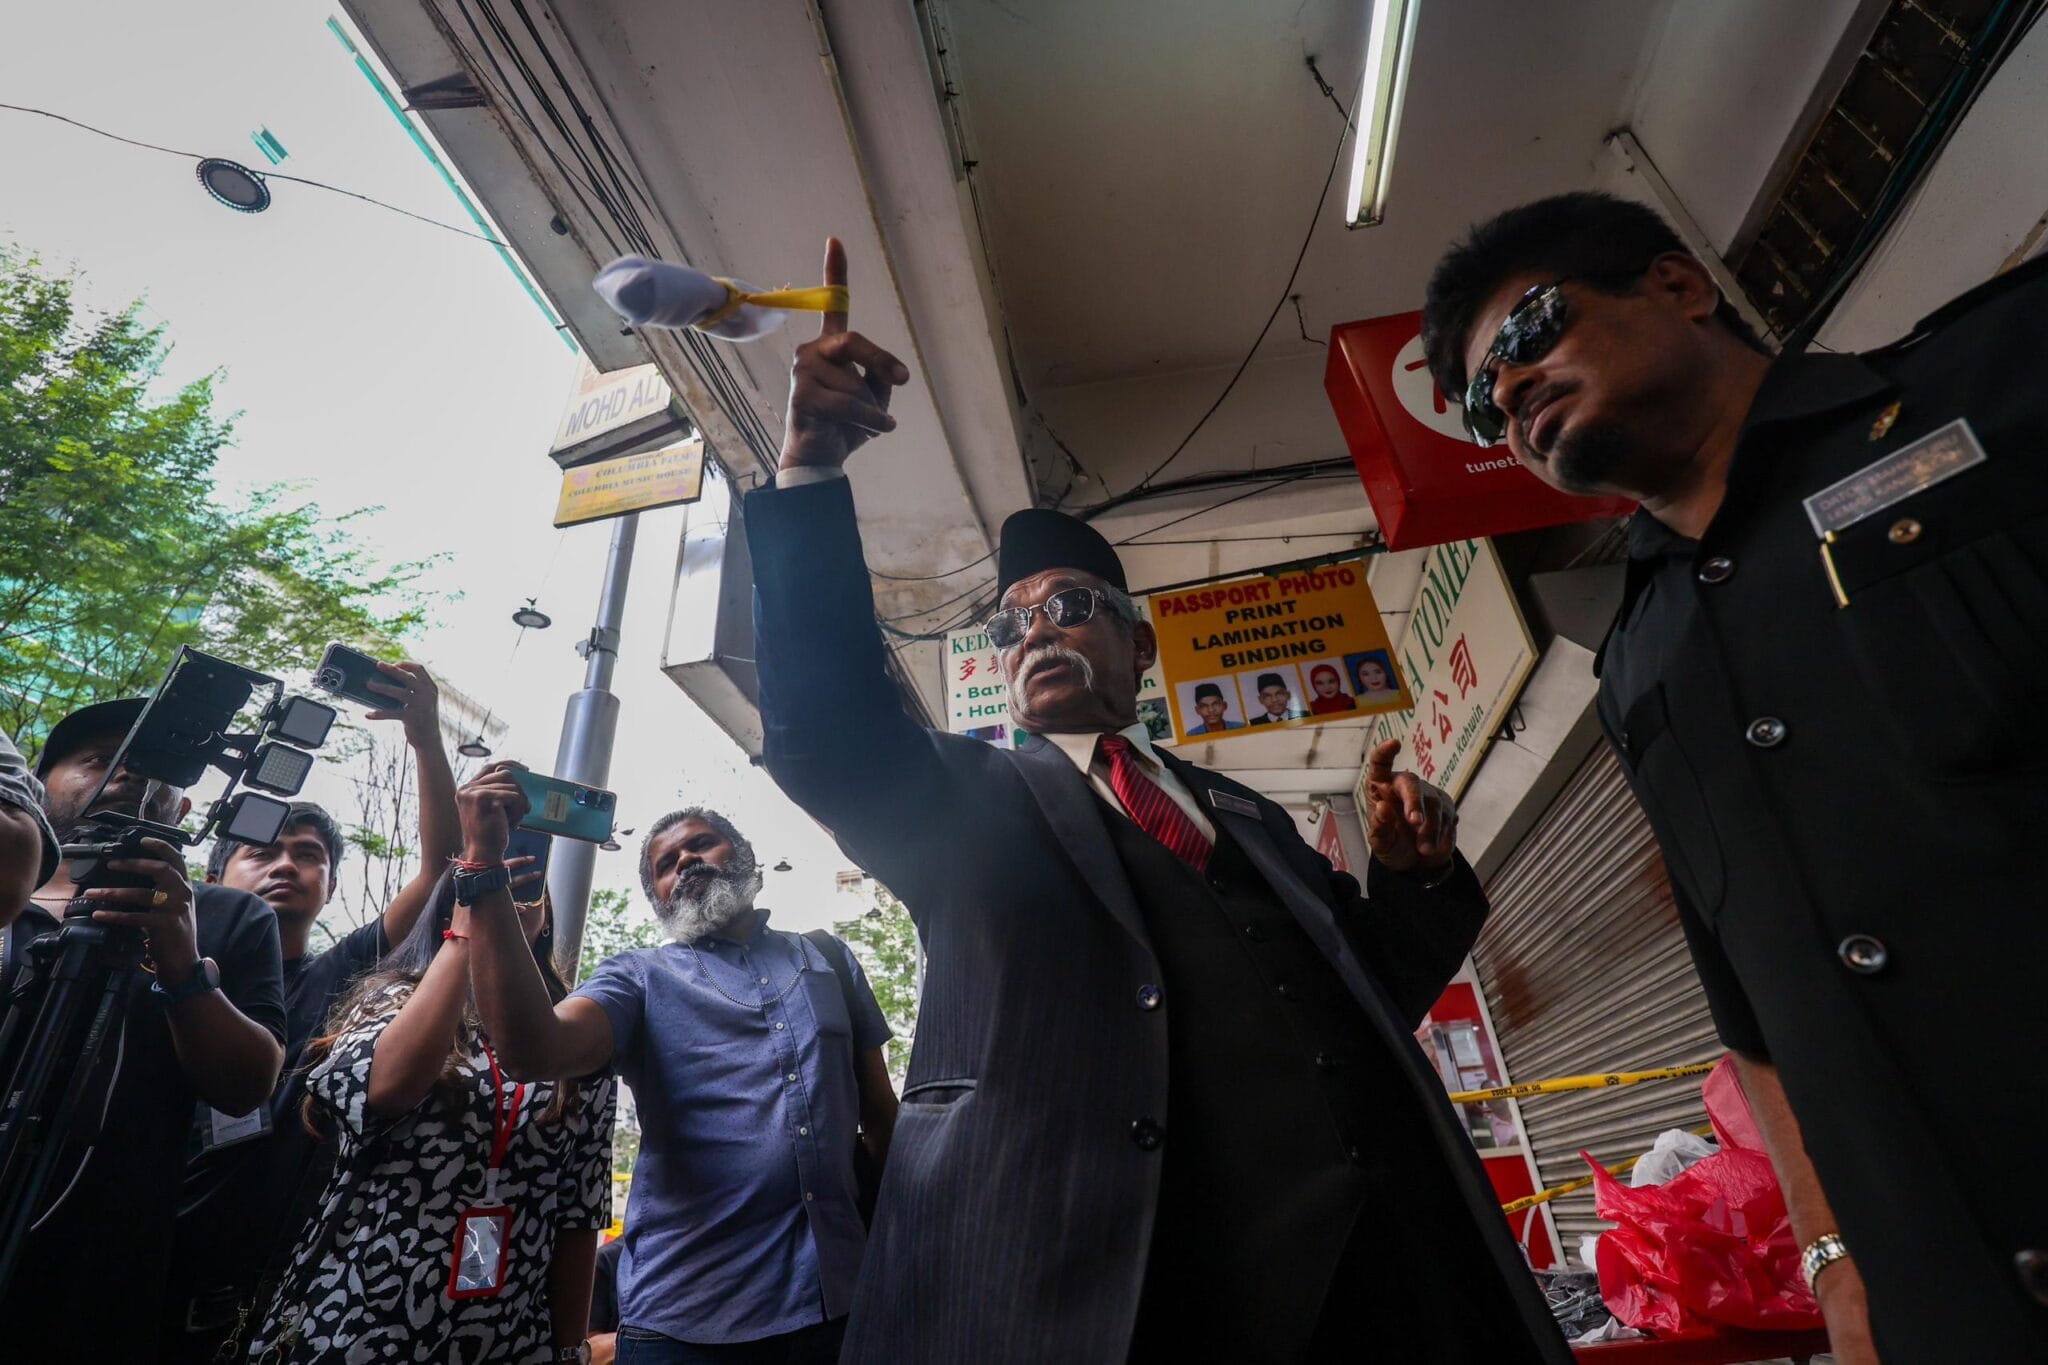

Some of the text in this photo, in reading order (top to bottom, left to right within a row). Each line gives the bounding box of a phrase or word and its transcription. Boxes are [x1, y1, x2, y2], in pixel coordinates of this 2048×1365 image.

[565, 376, 662, 437] MOHD ALI
[1159, 568, 1356, 617] PASSPORT PHOTO
[1225, 599, 1297, 625] PRINT
[1411, 537, 1479, 672] TOME
[951, 633, 992, 655] KED
[1192, 613, 1345, 652] LAMINATION
[1221, 638, 1327, 669] BINDING
[1411, 632, 1478, 780] 藝公司
[1455, 702, 1485, 753] Kahwin
